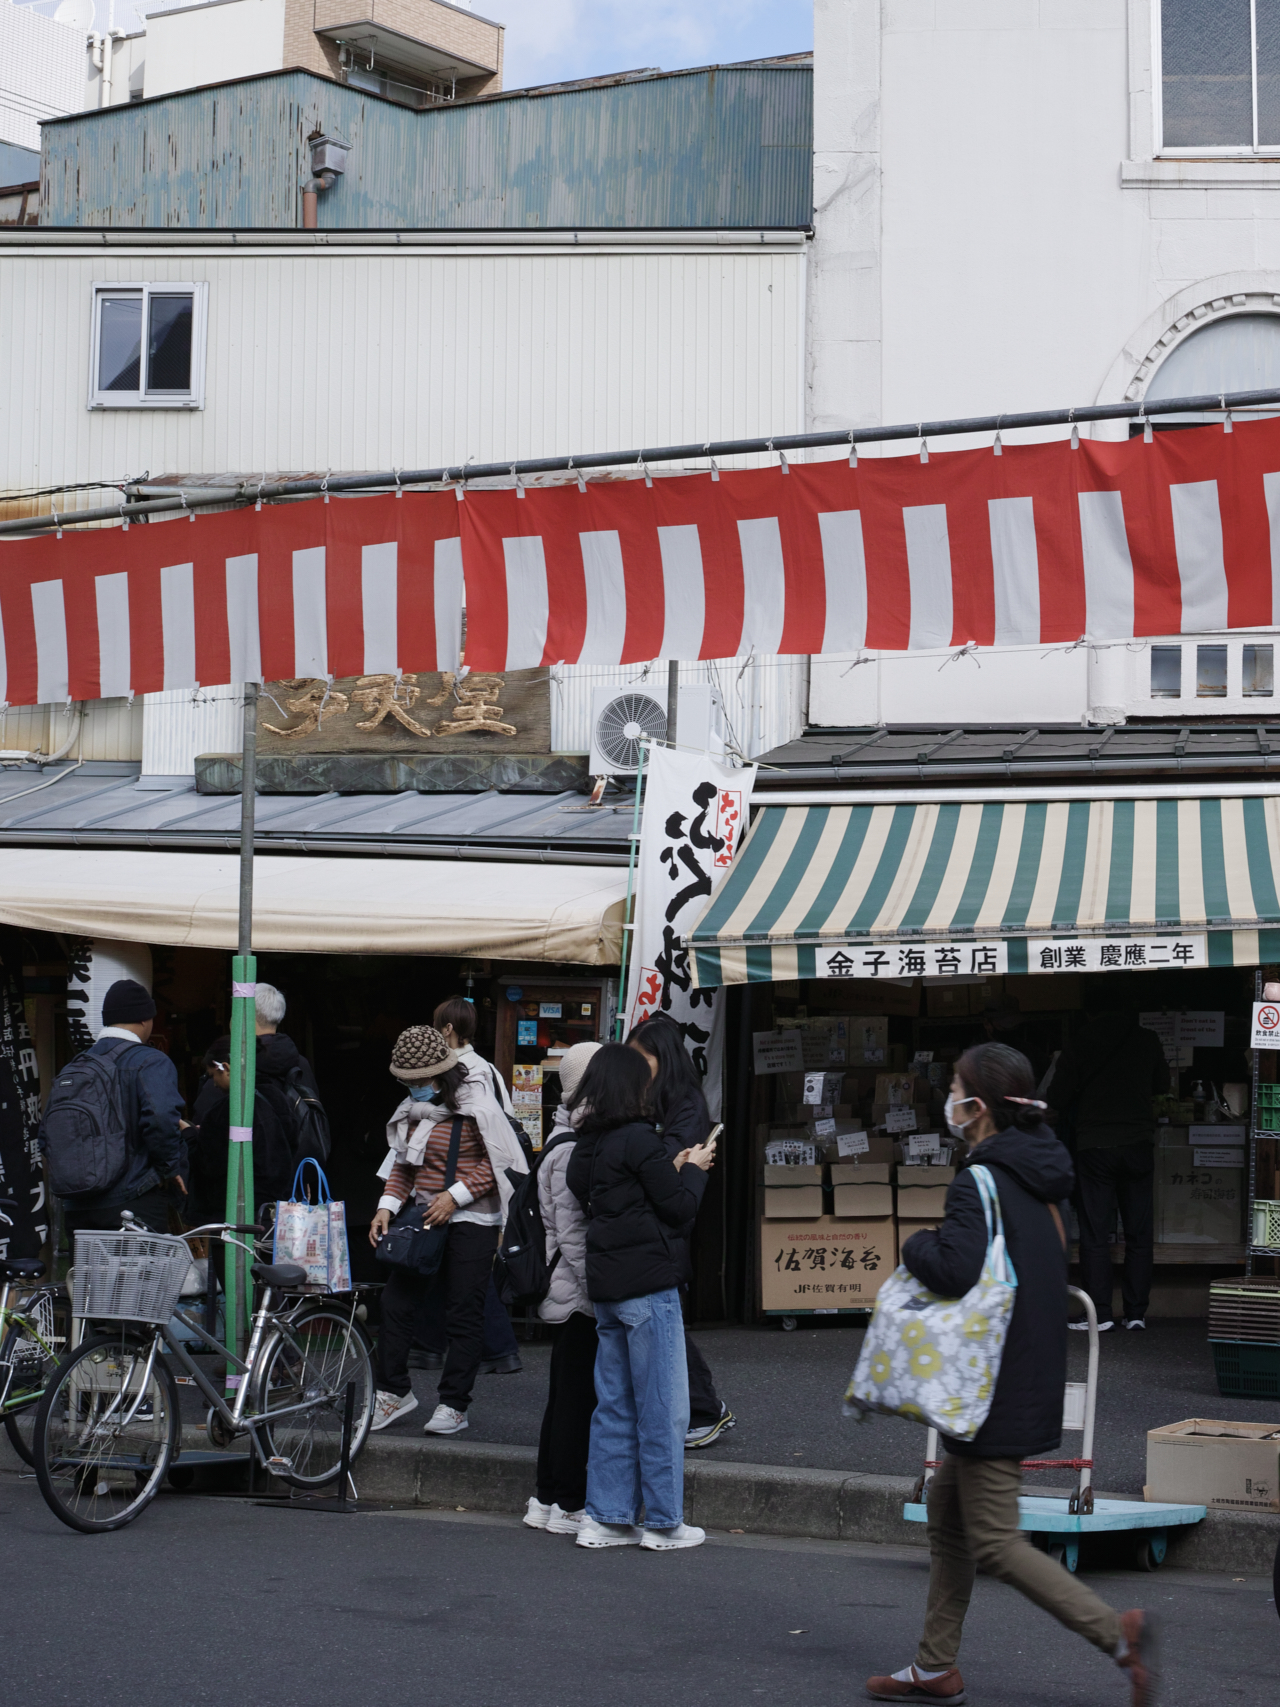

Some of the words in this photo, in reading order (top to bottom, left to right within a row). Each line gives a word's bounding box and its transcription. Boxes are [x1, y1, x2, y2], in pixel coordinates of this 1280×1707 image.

[826, 946, 998, 978] 金子海苔店
[1040, 946, 1087, 969] 創業
[1100, 942, 1195, 967] 慶應二年
[542, 1006, 561, 1014] VISA
[1171, 1171, 1222, 1185] カネコの
[787, 1233, 868, 1241] 伝統の風味と自然の香り
[775, 1246, 881, 1272] 佐賀海苔
